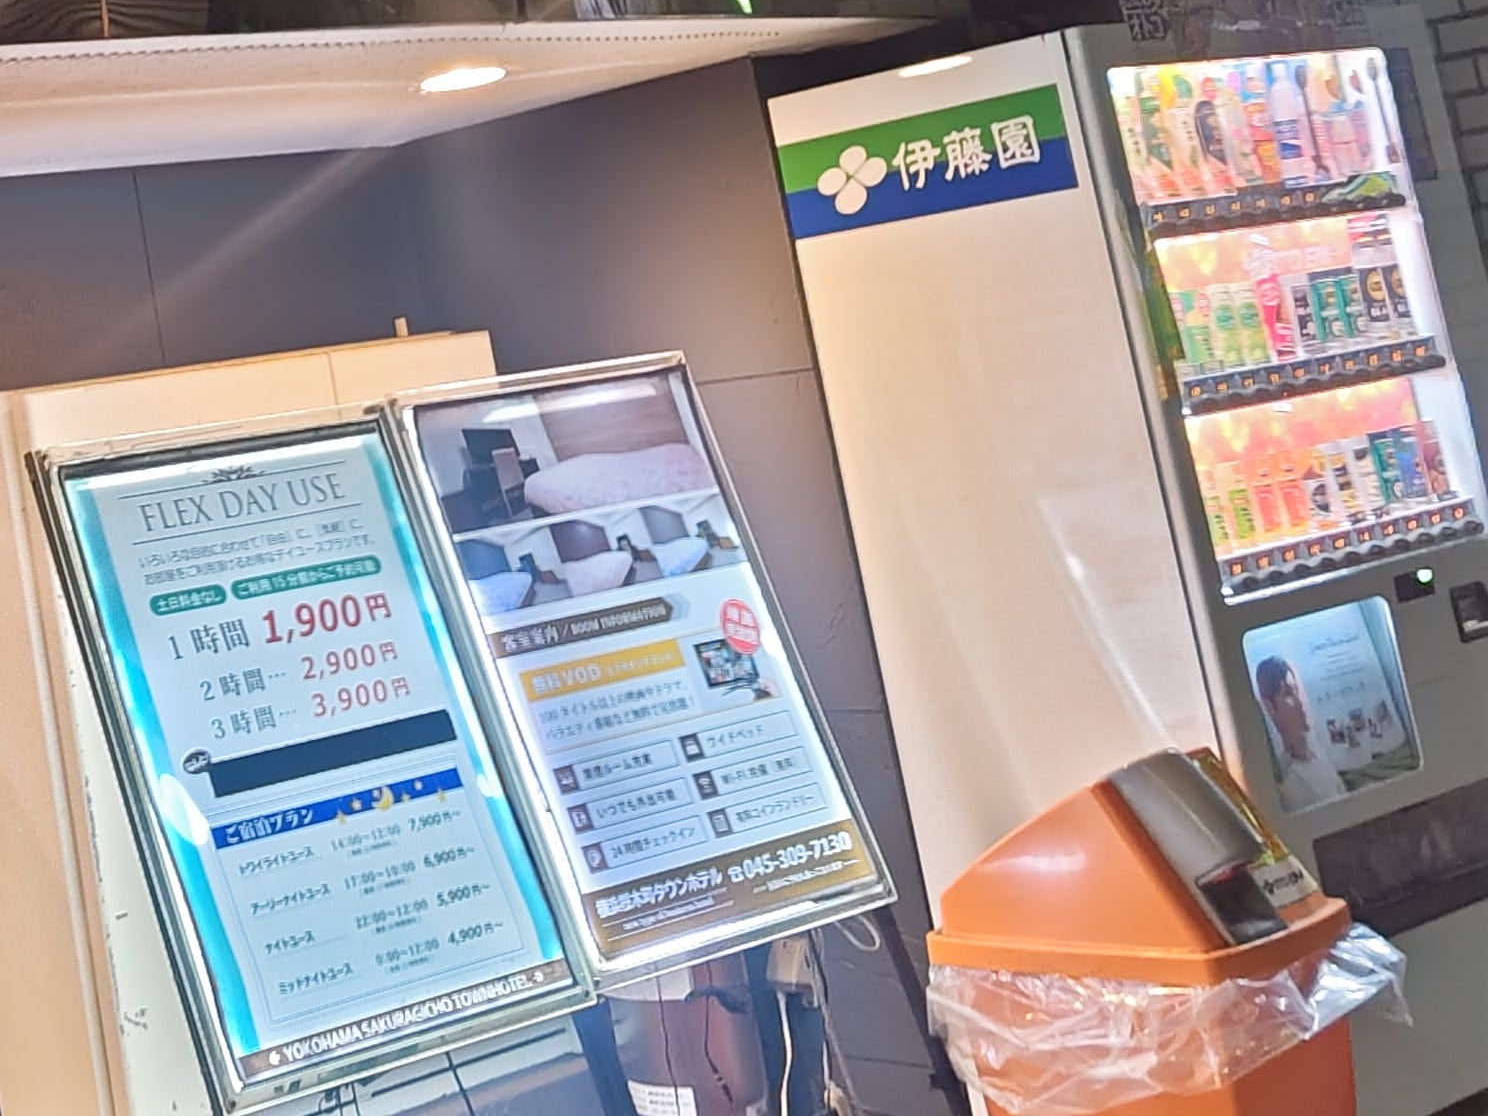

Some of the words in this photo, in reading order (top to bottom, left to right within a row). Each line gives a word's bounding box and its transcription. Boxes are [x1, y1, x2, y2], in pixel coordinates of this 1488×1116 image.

[892, 114, 1041, 190] 伊藤園
[138, 493, 216, 532] FLEX
[218, 483, 280, 520] DAY
[287, 472, 347, 508] USE
[261, 592, 393, 645] 1,900円
[301, 641, 398, 683] 2,900円
[311, 676, 411, 719] 3,900円
[281, 1024, 363, 1062] YOKOHAMA
